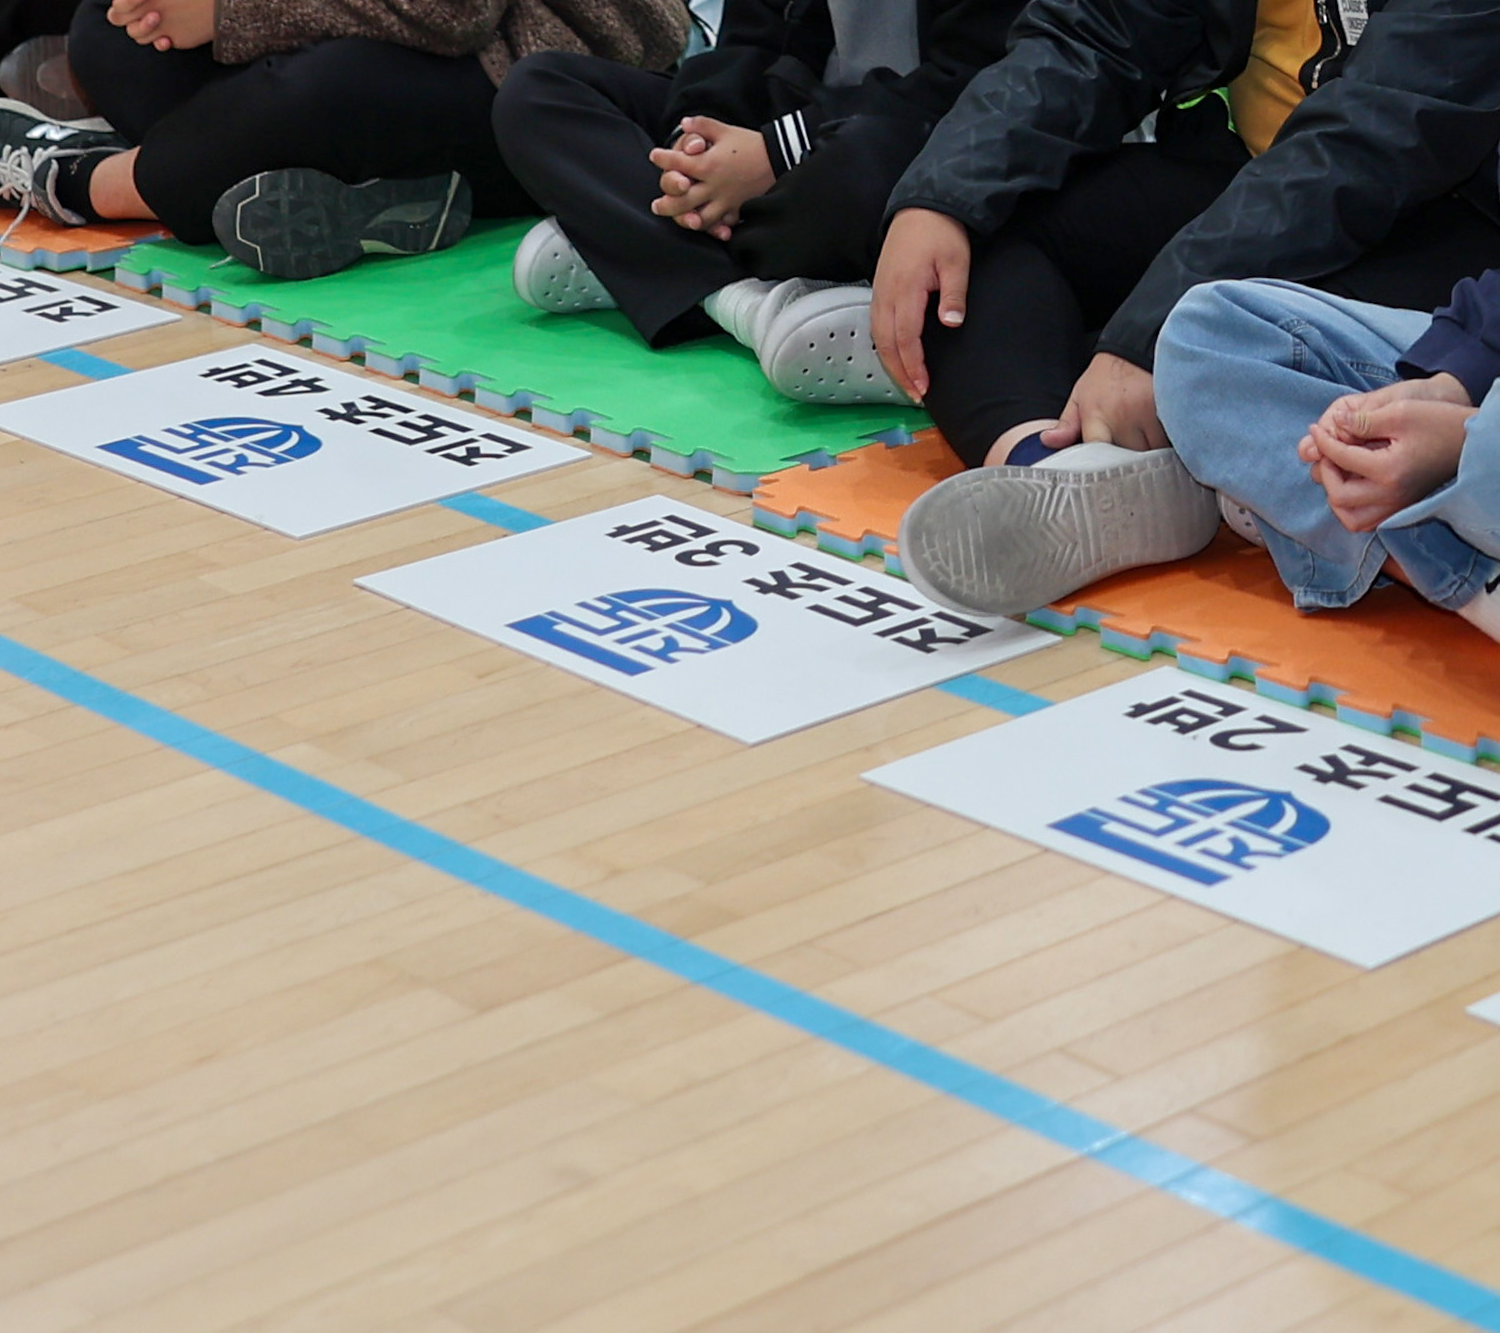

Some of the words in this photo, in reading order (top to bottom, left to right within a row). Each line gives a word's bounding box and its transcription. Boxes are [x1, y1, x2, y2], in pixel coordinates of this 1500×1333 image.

[197, 357, 333, 396] 4반
[318, 394, 530, 468] 진도초
[604, 513, 761, 570] 3반
[740, 561, 995, 656] 진도초
[1122, 688, 1312, 753] 2반
